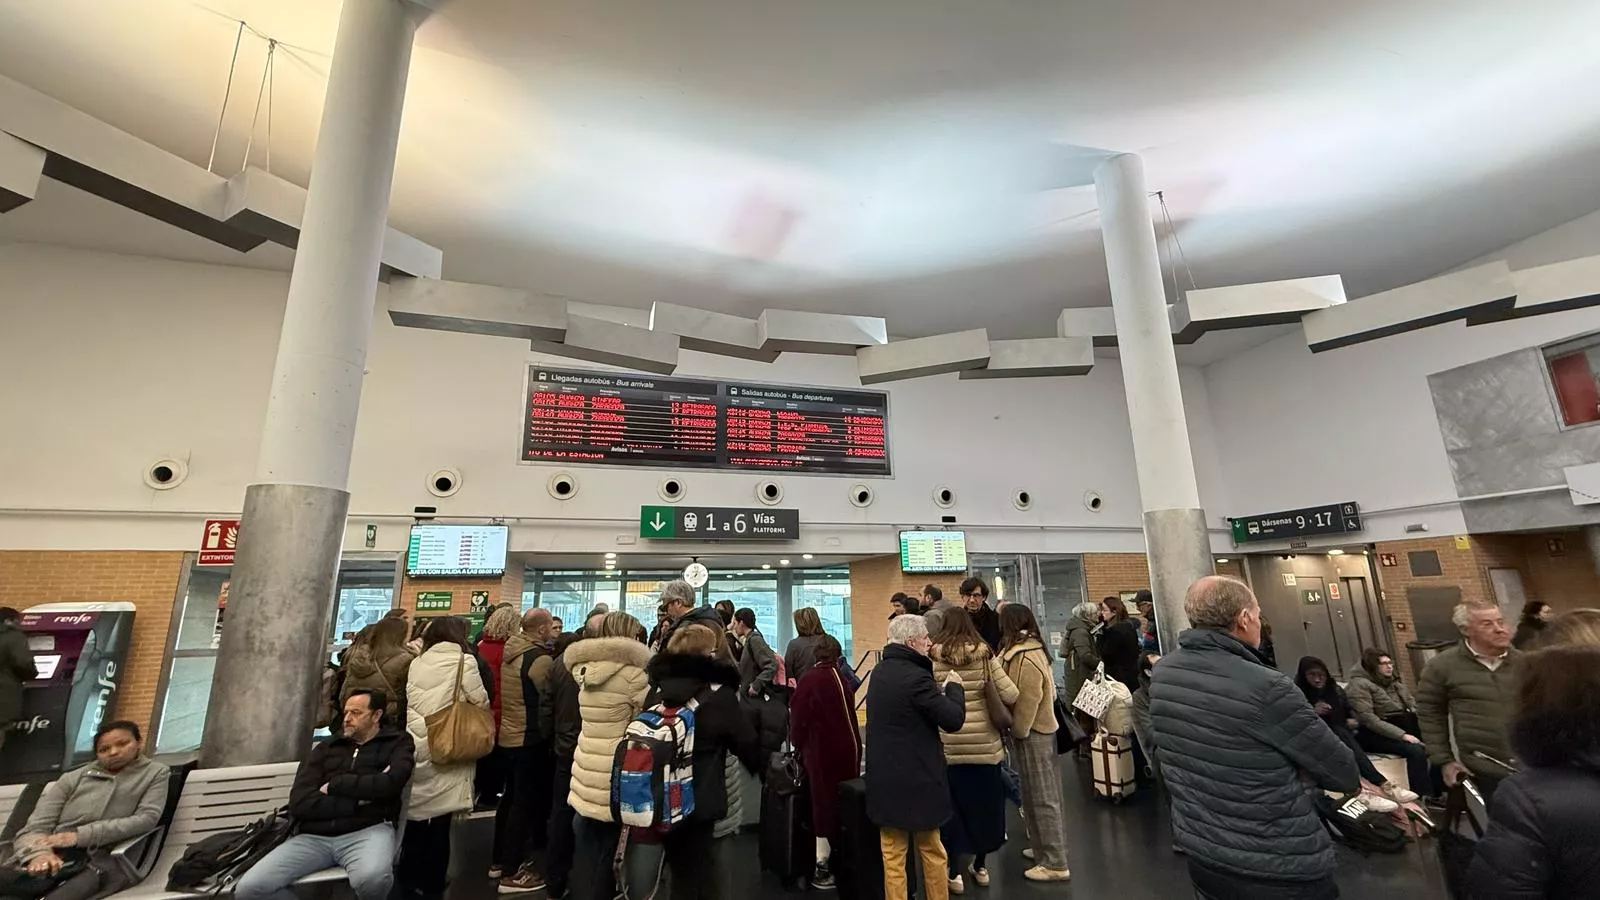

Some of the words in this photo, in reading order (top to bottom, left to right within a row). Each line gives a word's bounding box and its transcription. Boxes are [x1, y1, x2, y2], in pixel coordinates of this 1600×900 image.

[551, 374, 582, 384] Llegadas
[616, 379, 630, 387] Bus
[741, 388, 763, 396] Salidas
[705, 512, 717, 532] 1
[723, 521, 731, 531] a
[734, 513, 747, 534] 6
[753, 512, 775, 525] Vías
[1261, 517, 1293, 528] Dársenas
[1296, 515, 1305, 529] 9
[1314, 511, 1333, 528] 17
[753, 526, 786, 534] PLATFORMS
[54, 613, 92, 625] renfe
[89, 660, 117, 739] renfe
